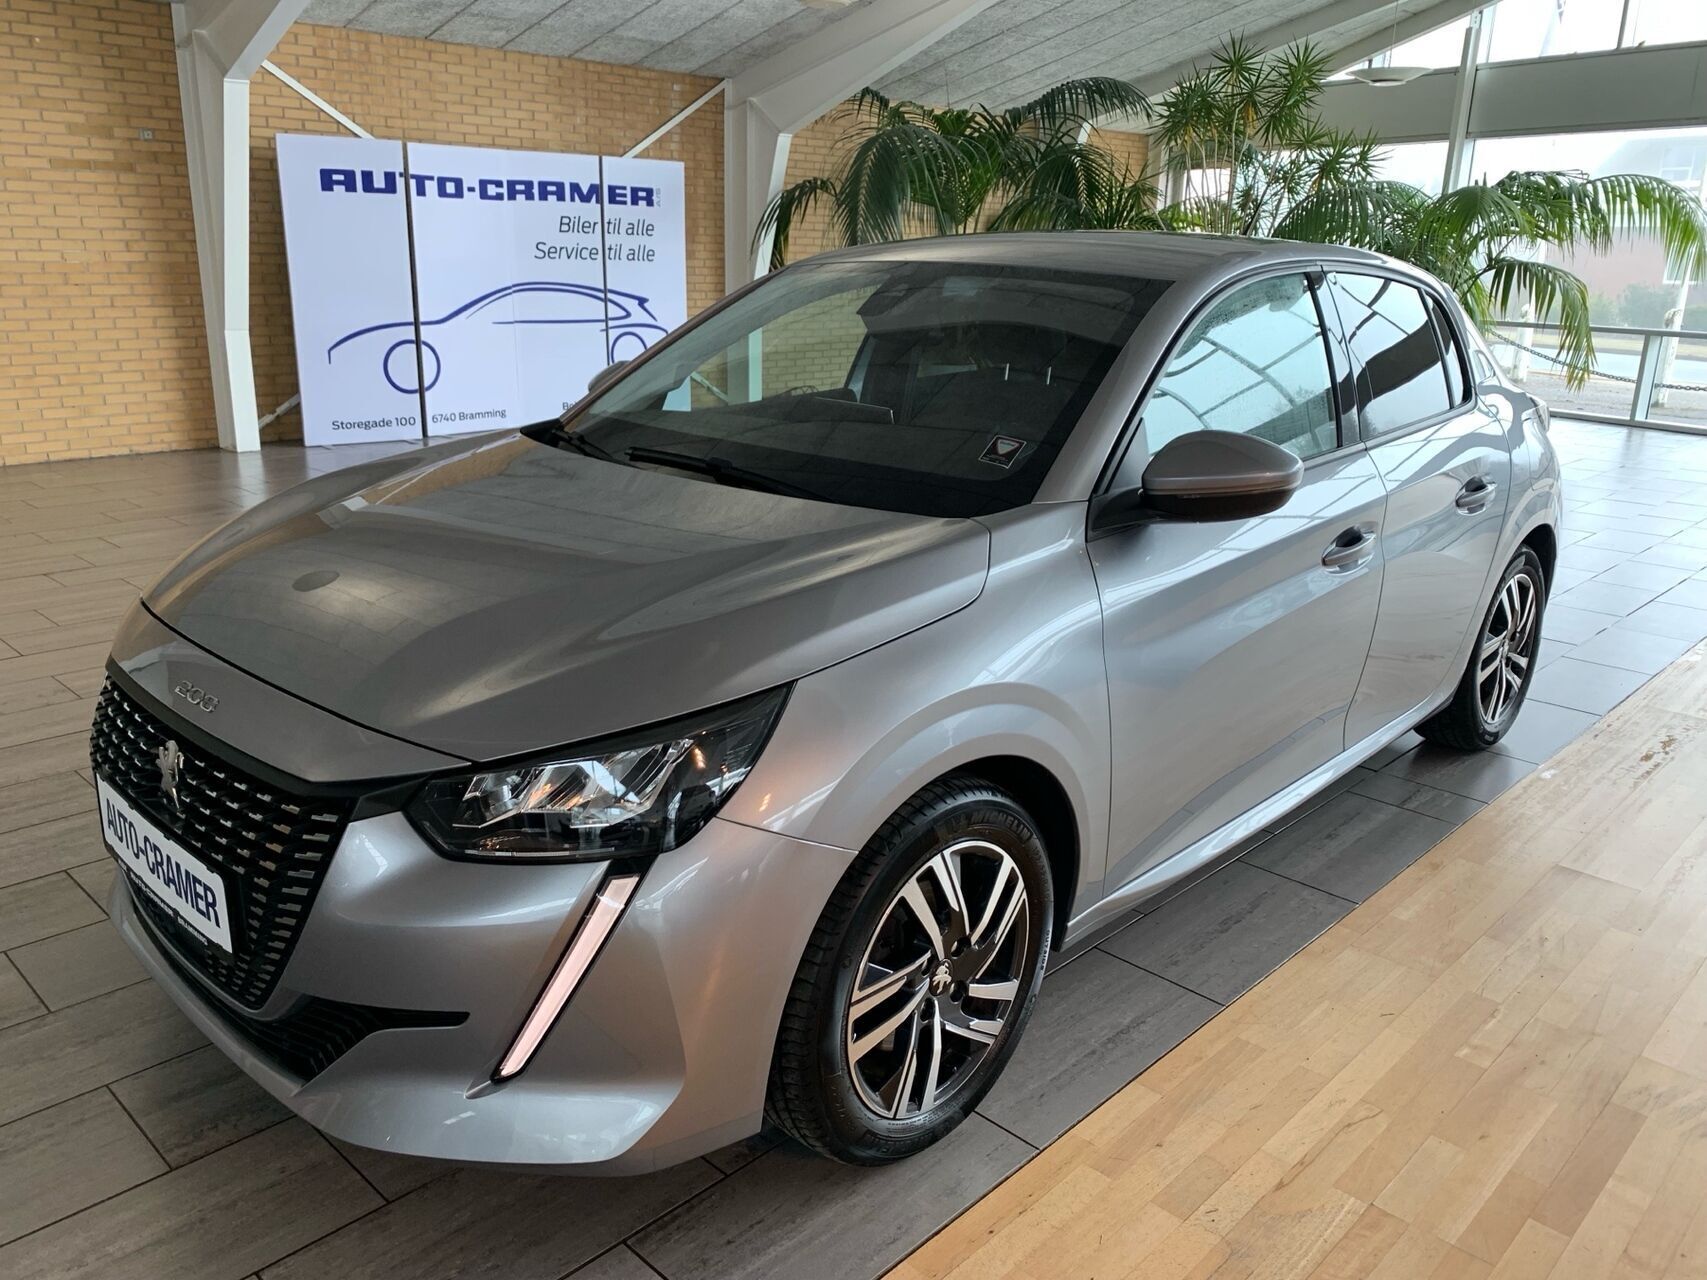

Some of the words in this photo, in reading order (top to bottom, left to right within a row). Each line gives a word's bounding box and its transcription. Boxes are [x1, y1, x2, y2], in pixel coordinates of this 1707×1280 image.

[319, 168, 655, 207] AUTO-CRAMER
[558, 215, 598, 234] Biler
[606, 217, 621, 235] til
[625, 218, 655, 236] alle
[534, 241, 599, 260] Service
[607, 243, 622, 260] til
[626, 244, 655, 261] alle
[331, 418, 393, 431] Storegade
[395, 416, 416, 427] 100
[431, 413, 457, 424] 6740
[458, 408, 507, 422] Bramming
[174, 680, 219, 712] 208
[969, 808, 1034, 840] MICHELIN
[106, 798, 221, 929] AUTO-CRAMER
